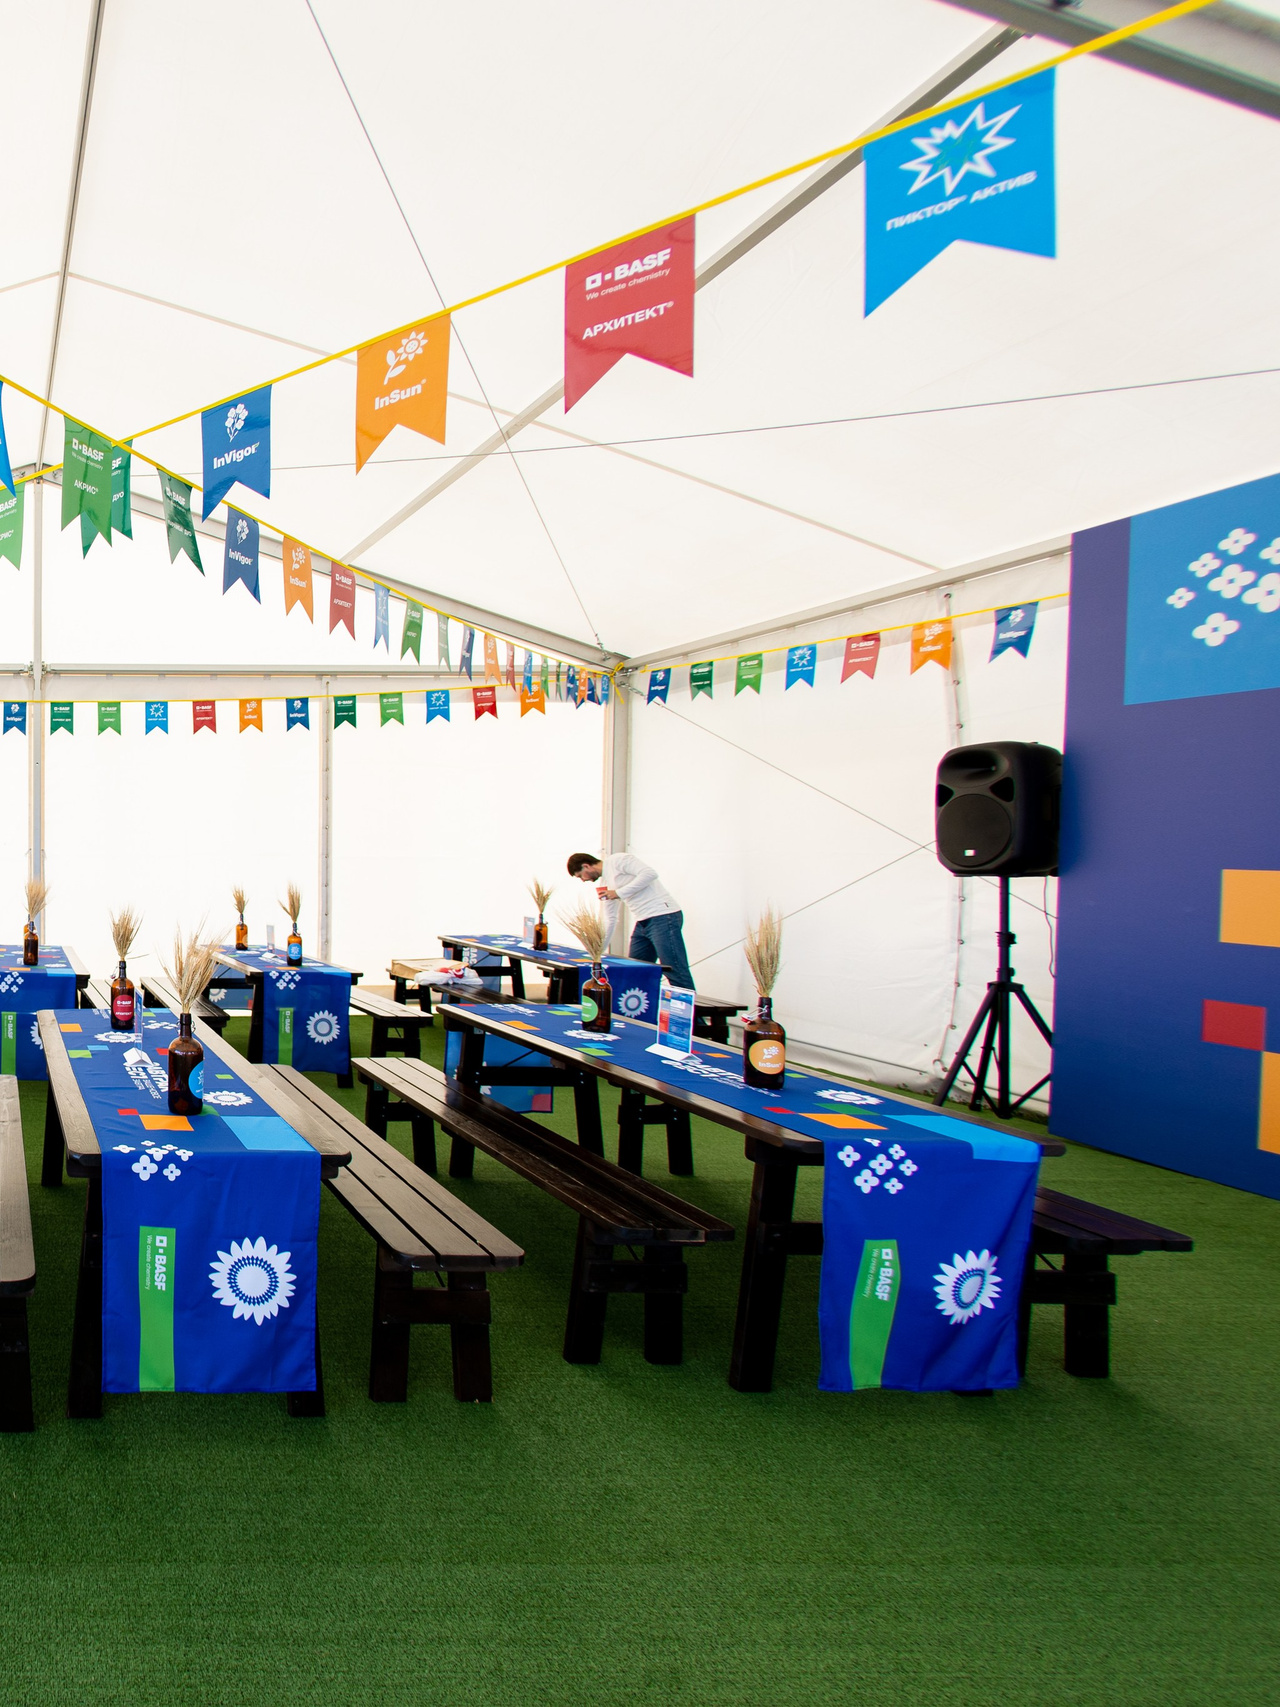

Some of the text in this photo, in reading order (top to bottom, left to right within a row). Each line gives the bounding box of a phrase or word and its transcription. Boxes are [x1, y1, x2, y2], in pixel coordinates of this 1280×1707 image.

[969, 170, 1038, 204] АКТИВ
[614, 248, 672, 281] BASF
[585, 268, 671, 301] We create chemistry
[81, 443, 104, 462] BASF
[112, 457, 122, 470] SF
[213, 442, 260, 469] InVigor
[0, 497, 17, 513] BASF
[228, 548, 254, 566] InVigor
[154, 1254, 167, 1291] BASF
[875, 1267, 893, 1301] BASF
